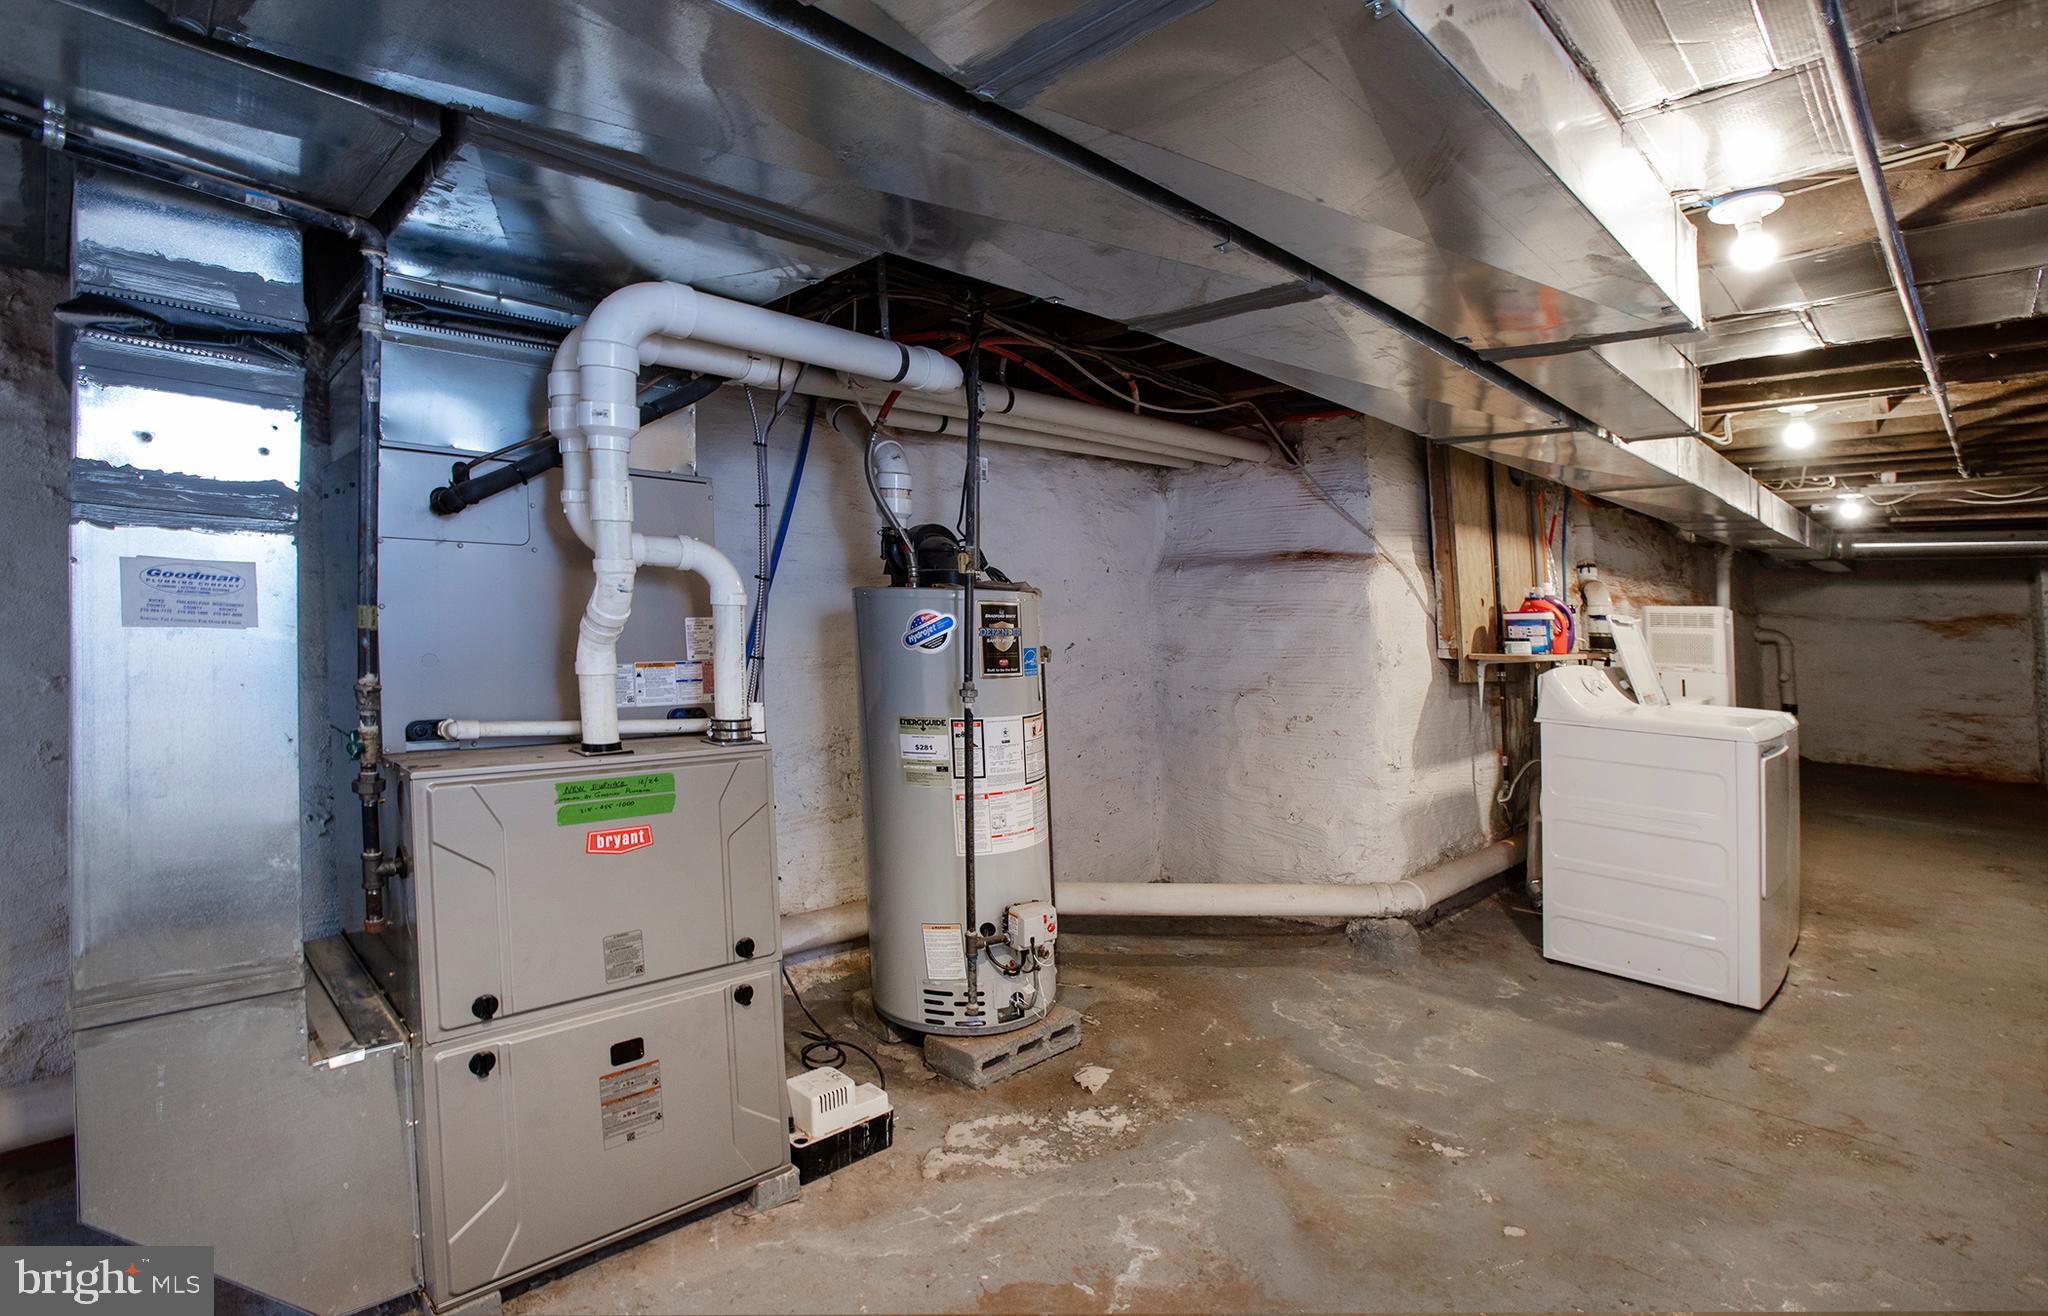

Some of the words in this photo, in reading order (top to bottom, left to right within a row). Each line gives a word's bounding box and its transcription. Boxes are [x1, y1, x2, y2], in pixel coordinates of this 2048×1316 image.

[146, 568, 240, 583] Goodman
[145, 578, 193, 586] PLUMBING
[979, 628, 1021, 637] DEFENDER
[563, 785, 585, 795] NEW
[596, 829, 645, 849] bryant
